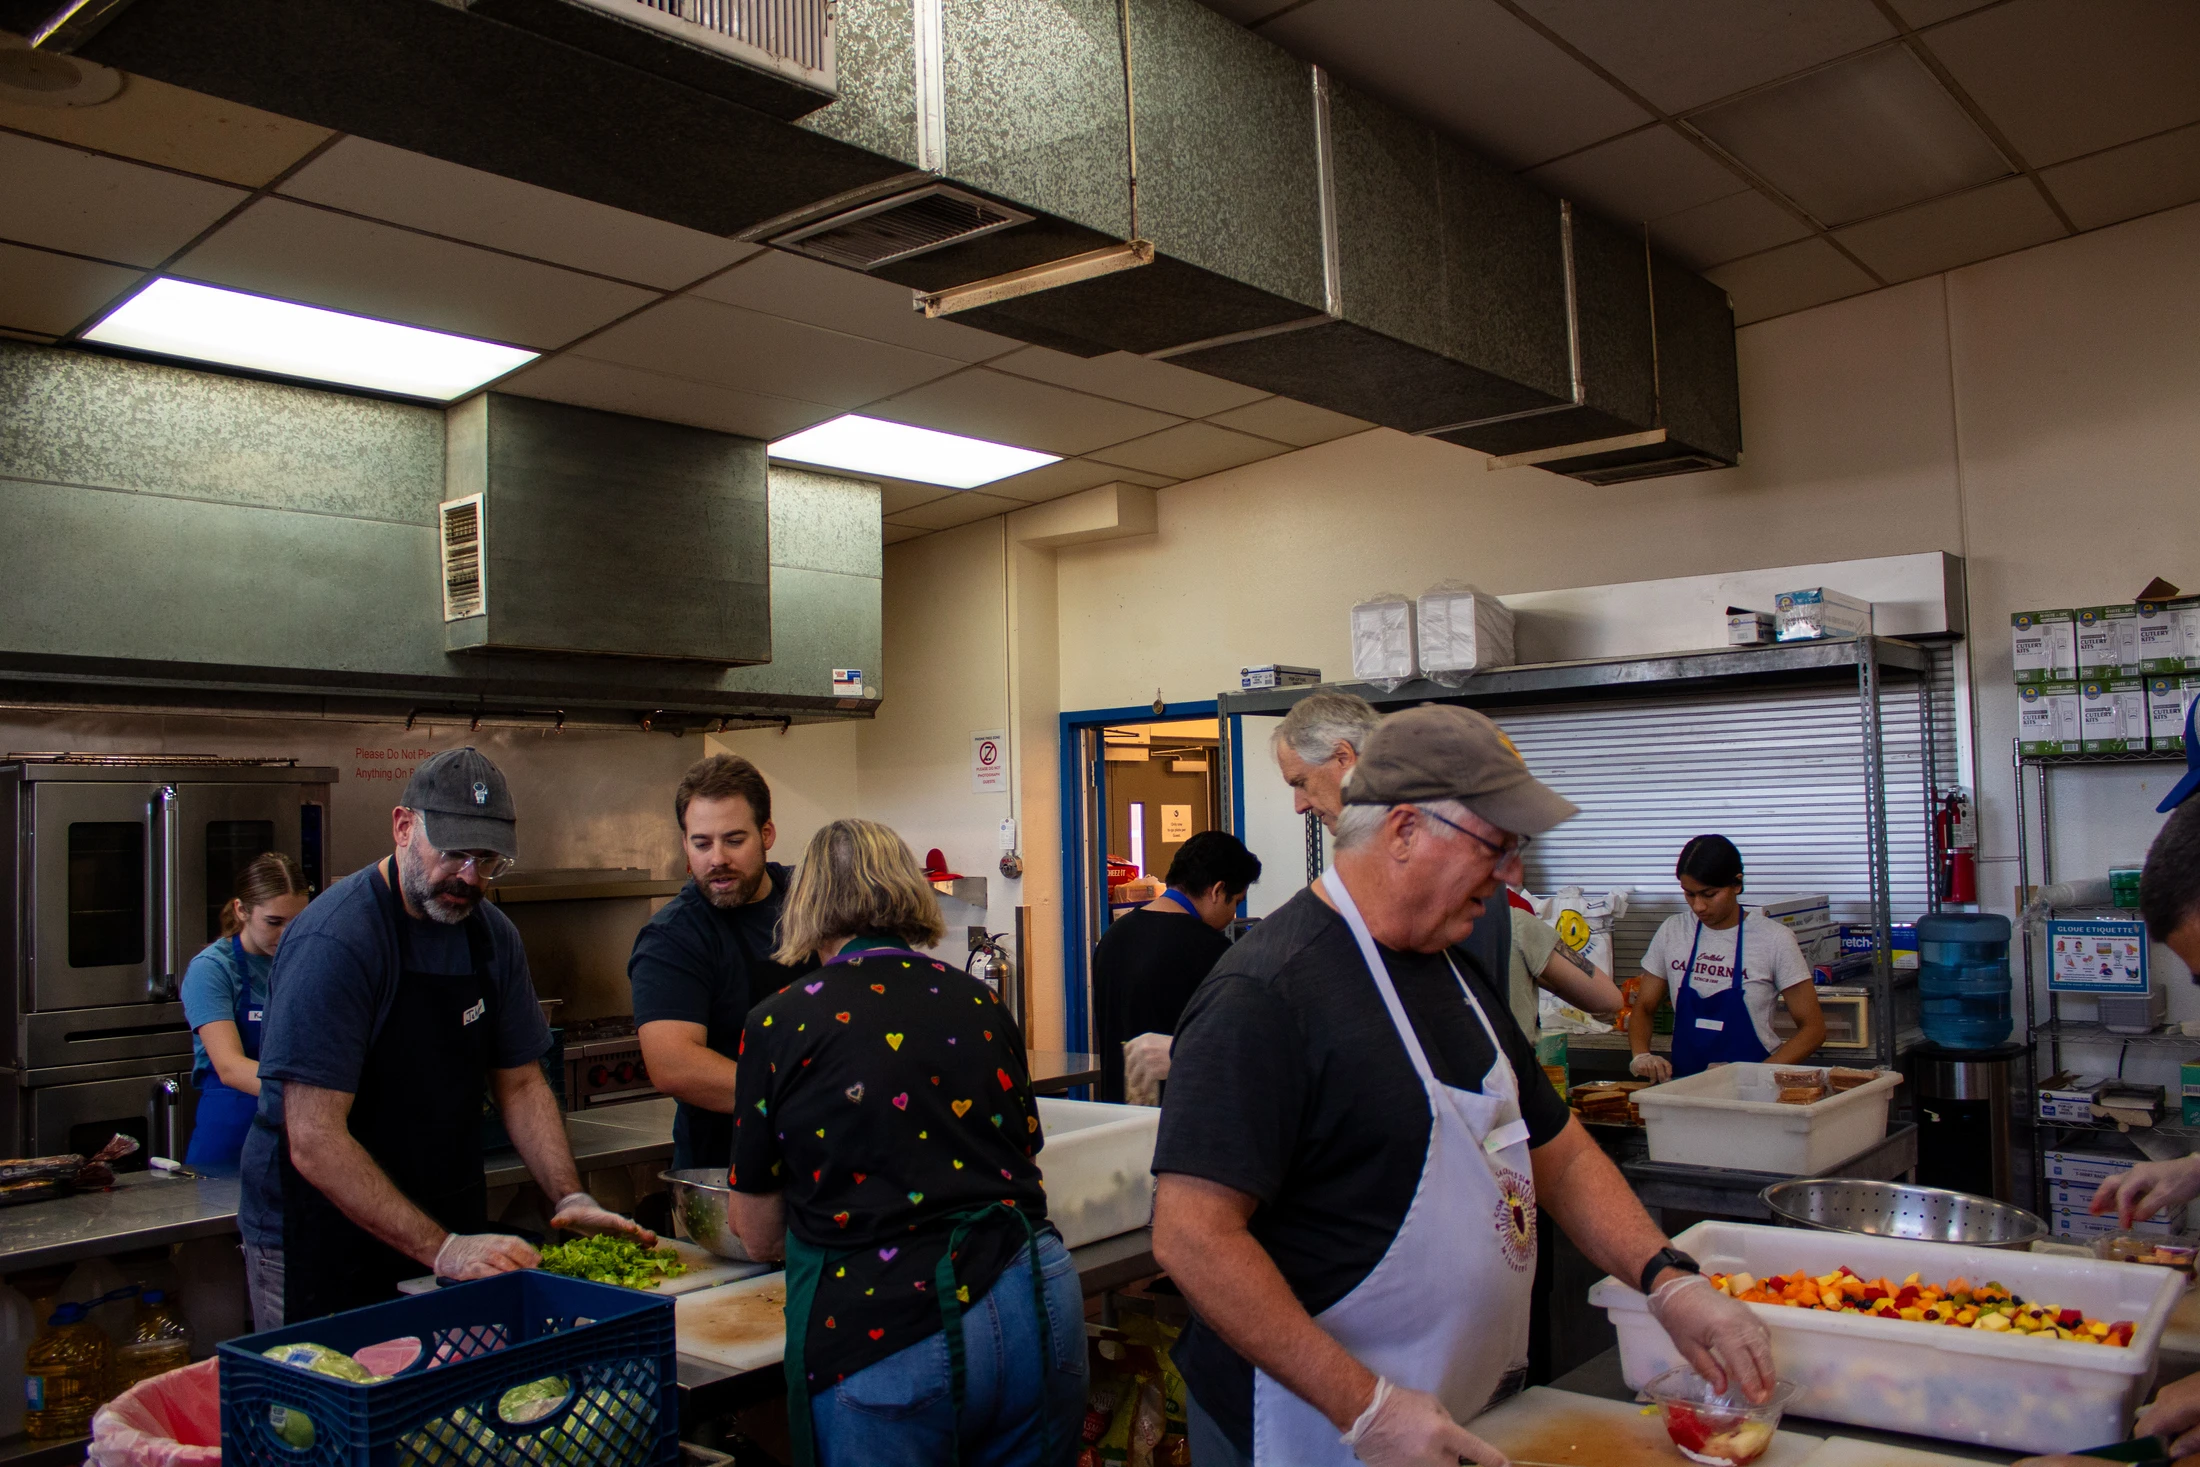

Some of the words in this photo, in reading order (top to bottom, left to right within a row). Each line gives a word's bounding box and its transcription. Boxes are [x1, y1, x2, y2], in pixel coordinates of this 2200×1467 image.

[355, 747, 385, 759] Please
[387, 748, 399, 760] Do
[401, 749, 416, 759] Not
[418, 749, 440, 759] Plac
[355, 767, 393, 781] Anything
[395, 767, 407, 779] On
[2086, 926, 2133, 934] ETIQUETTE
[1671, 959, 1749, 979] CAIFORNA
